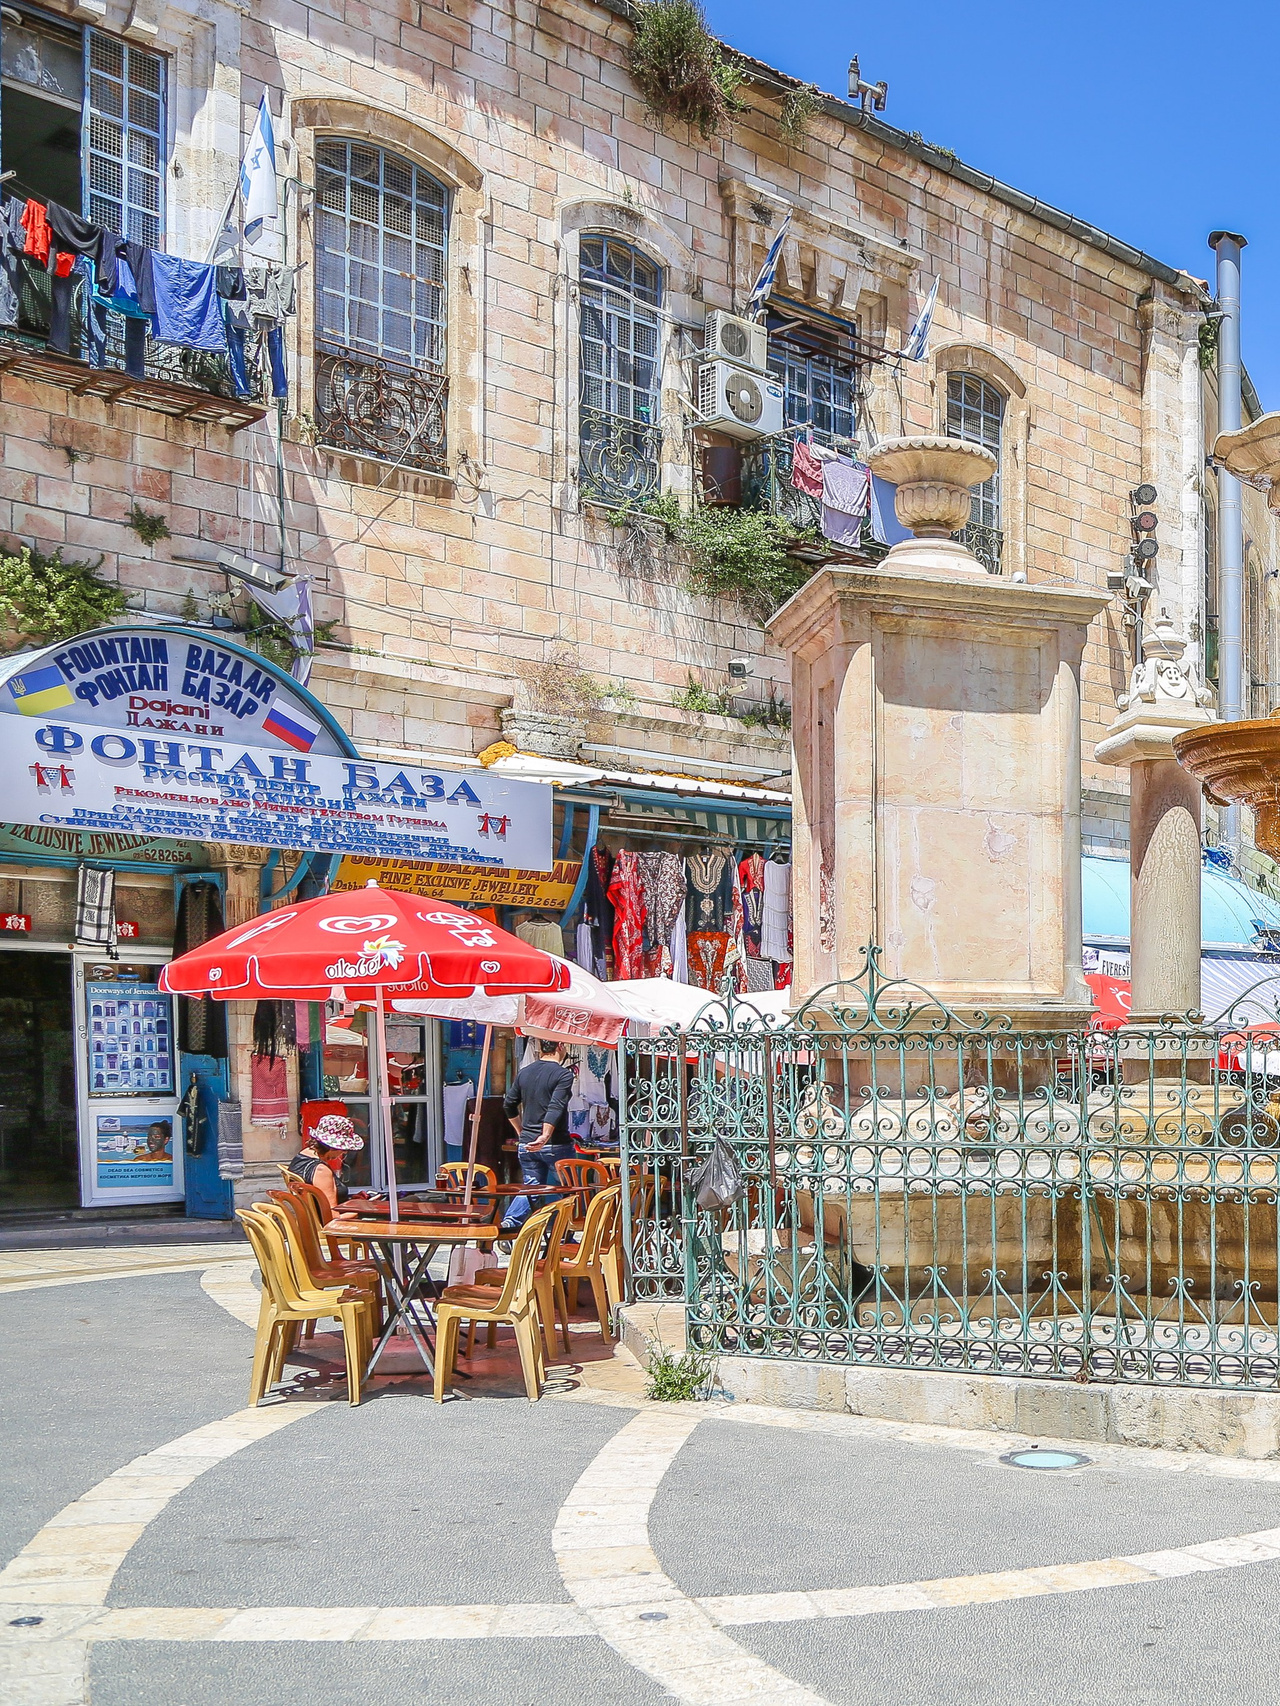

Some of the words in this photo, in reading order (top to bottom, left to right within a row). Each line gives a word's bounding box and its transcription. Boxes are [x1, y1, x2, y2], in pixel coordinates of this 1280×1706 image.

[53, 637, 169, 682] FOUNTAIN
[185, 644, 277, 704] BAZAAR
[75, 665, 168, 707] ФОНТАН
[181, 670, 259, 720] БАЗАР
[129, 695, 210, 720] Dajani
[35, 725, 312, 783] ФОНТАН
[342, 763, 482, 803] БАЗА
[378, 871, 412, 886] FINE
[413, 873, 471, 890] EXCLUSIVE
[473, 880, 540, 897] JEWELLERY
[431, 889, 444, 898] 64
[490, 893, 567, 908] 02-6282654
[90, 986, 124, 996] Doorways
[125, 986, 132, 994] of
